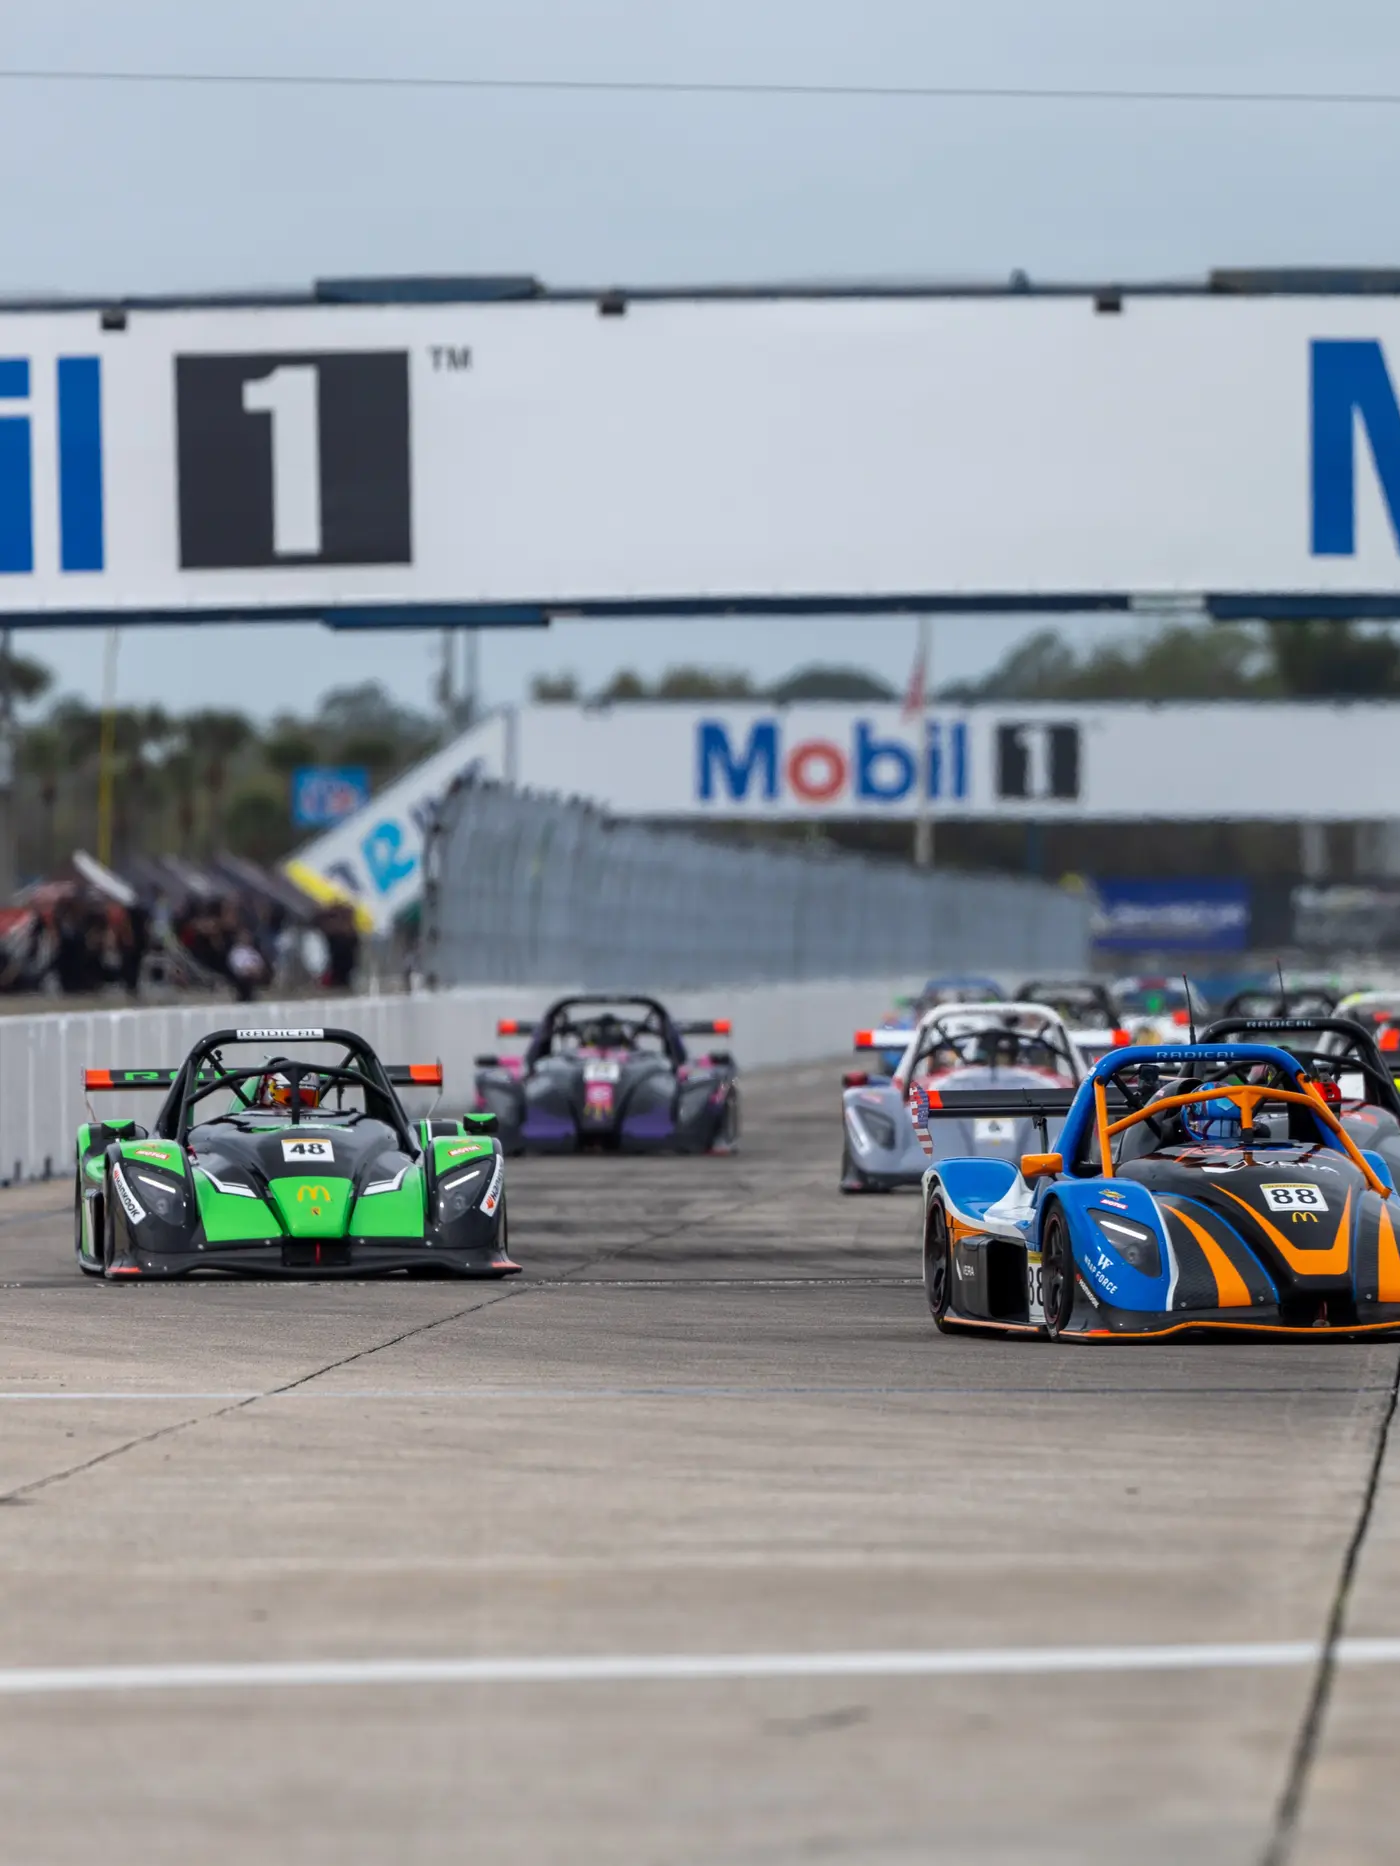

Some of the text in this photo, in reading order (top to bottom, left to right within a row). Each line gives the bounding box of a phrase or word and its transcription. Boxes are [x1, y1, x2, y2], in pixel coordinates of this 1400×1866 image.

[243, 365, 321, 555] 1
[695, 718, 970, 804] Mobil
[1156, 1051, 1237, 1059] RADICAL
[289, 1142, 326, 1155] 48
[1270, 1188, 1318, 1205] 88
[1095, 1271, 1119, 1295] FORCE
